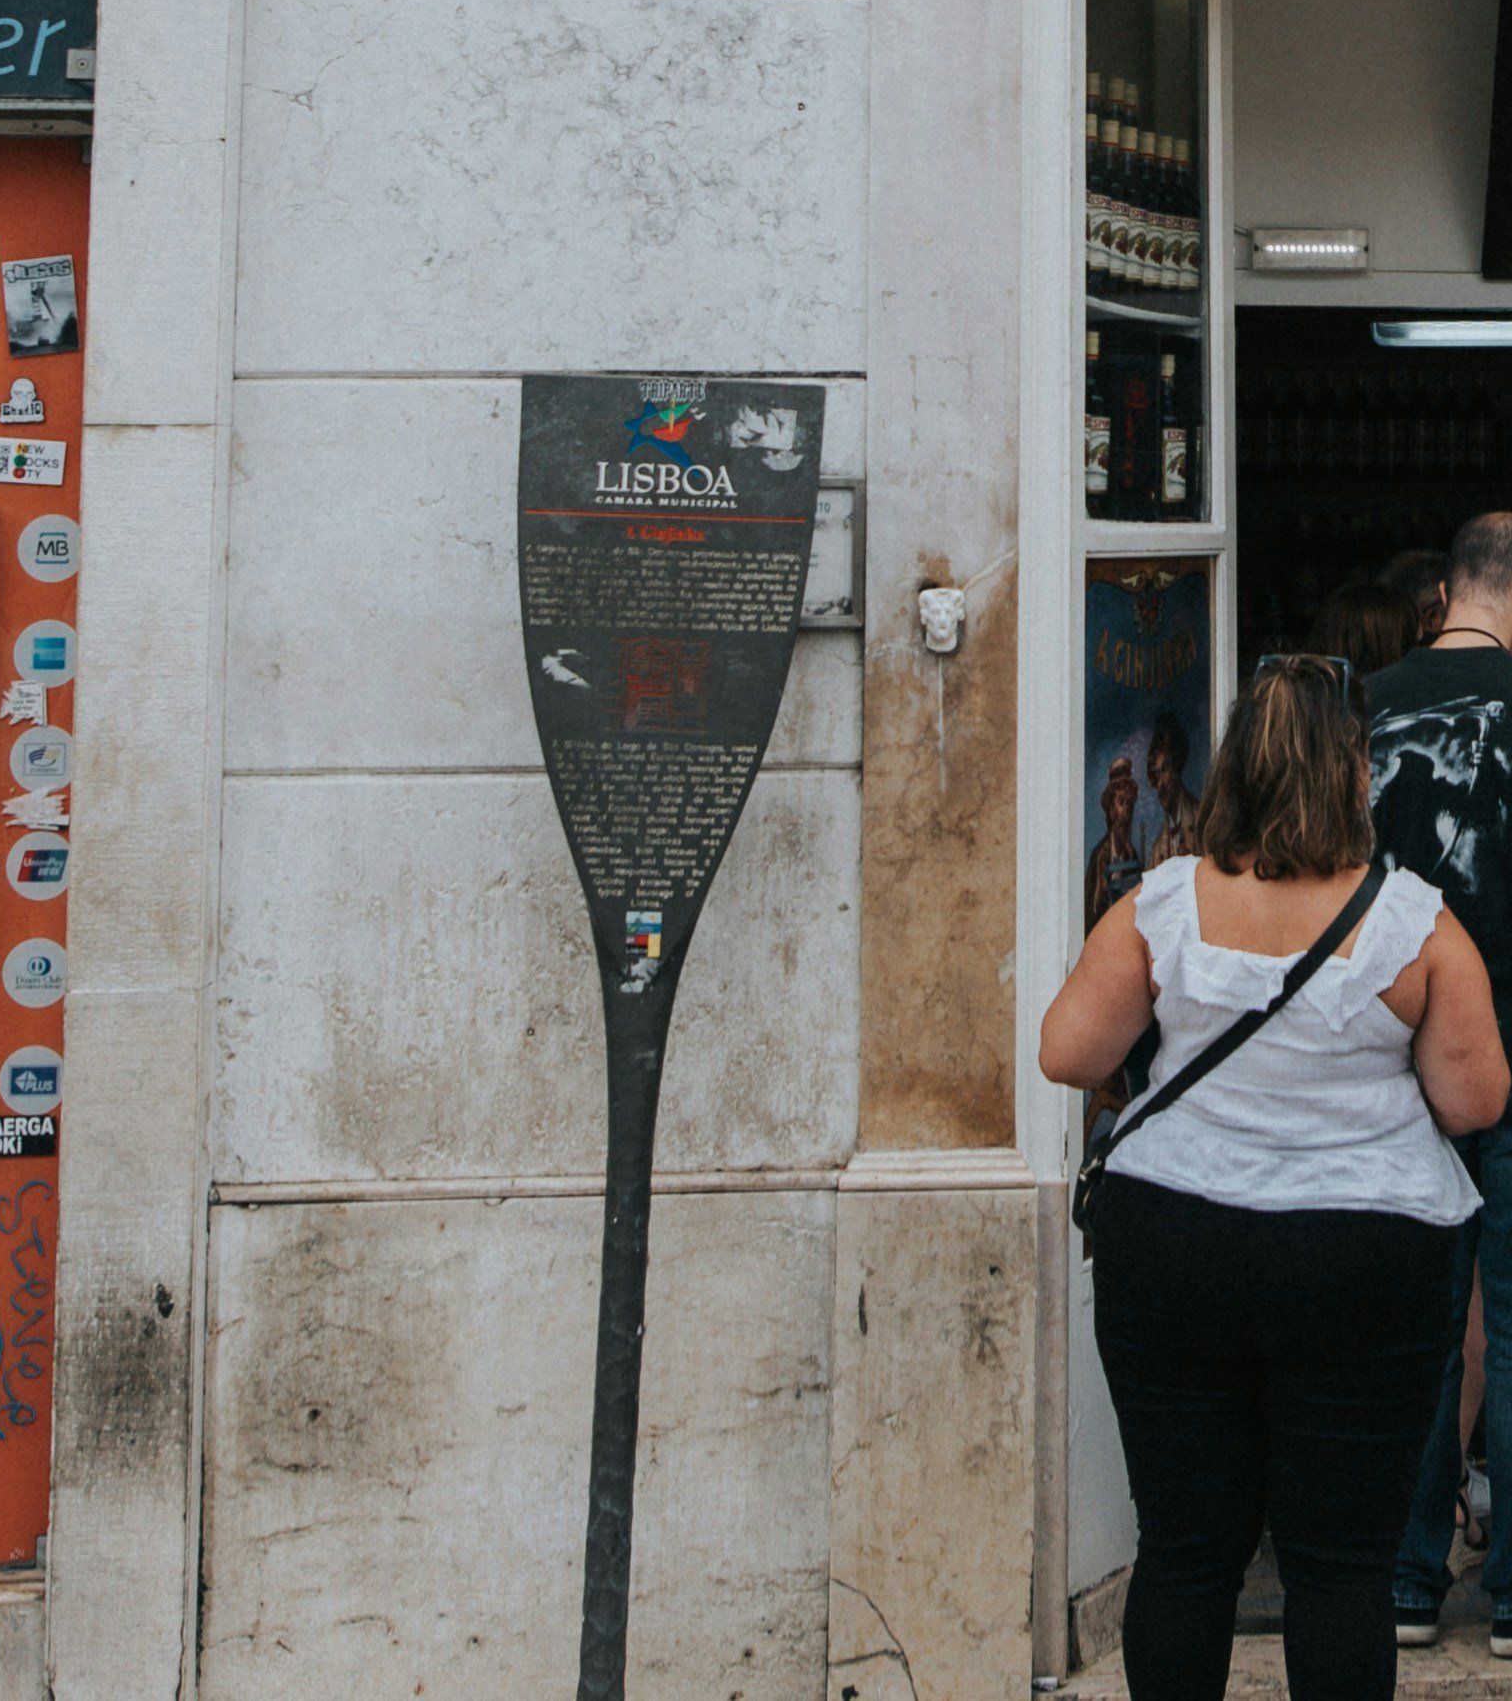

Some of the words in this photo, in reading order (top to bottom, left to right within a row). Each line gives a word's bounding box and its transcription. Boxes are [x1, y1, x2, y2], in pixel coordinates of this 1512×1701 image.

[595, 461, 738, 497] LISBOA
[594, 495, 653, 505] CAMARA
[658, 496, 738, 509] MUNICIPAL
[35, 540, 70, 557] MB
[25, 1080, 55, 1092] PLUS
